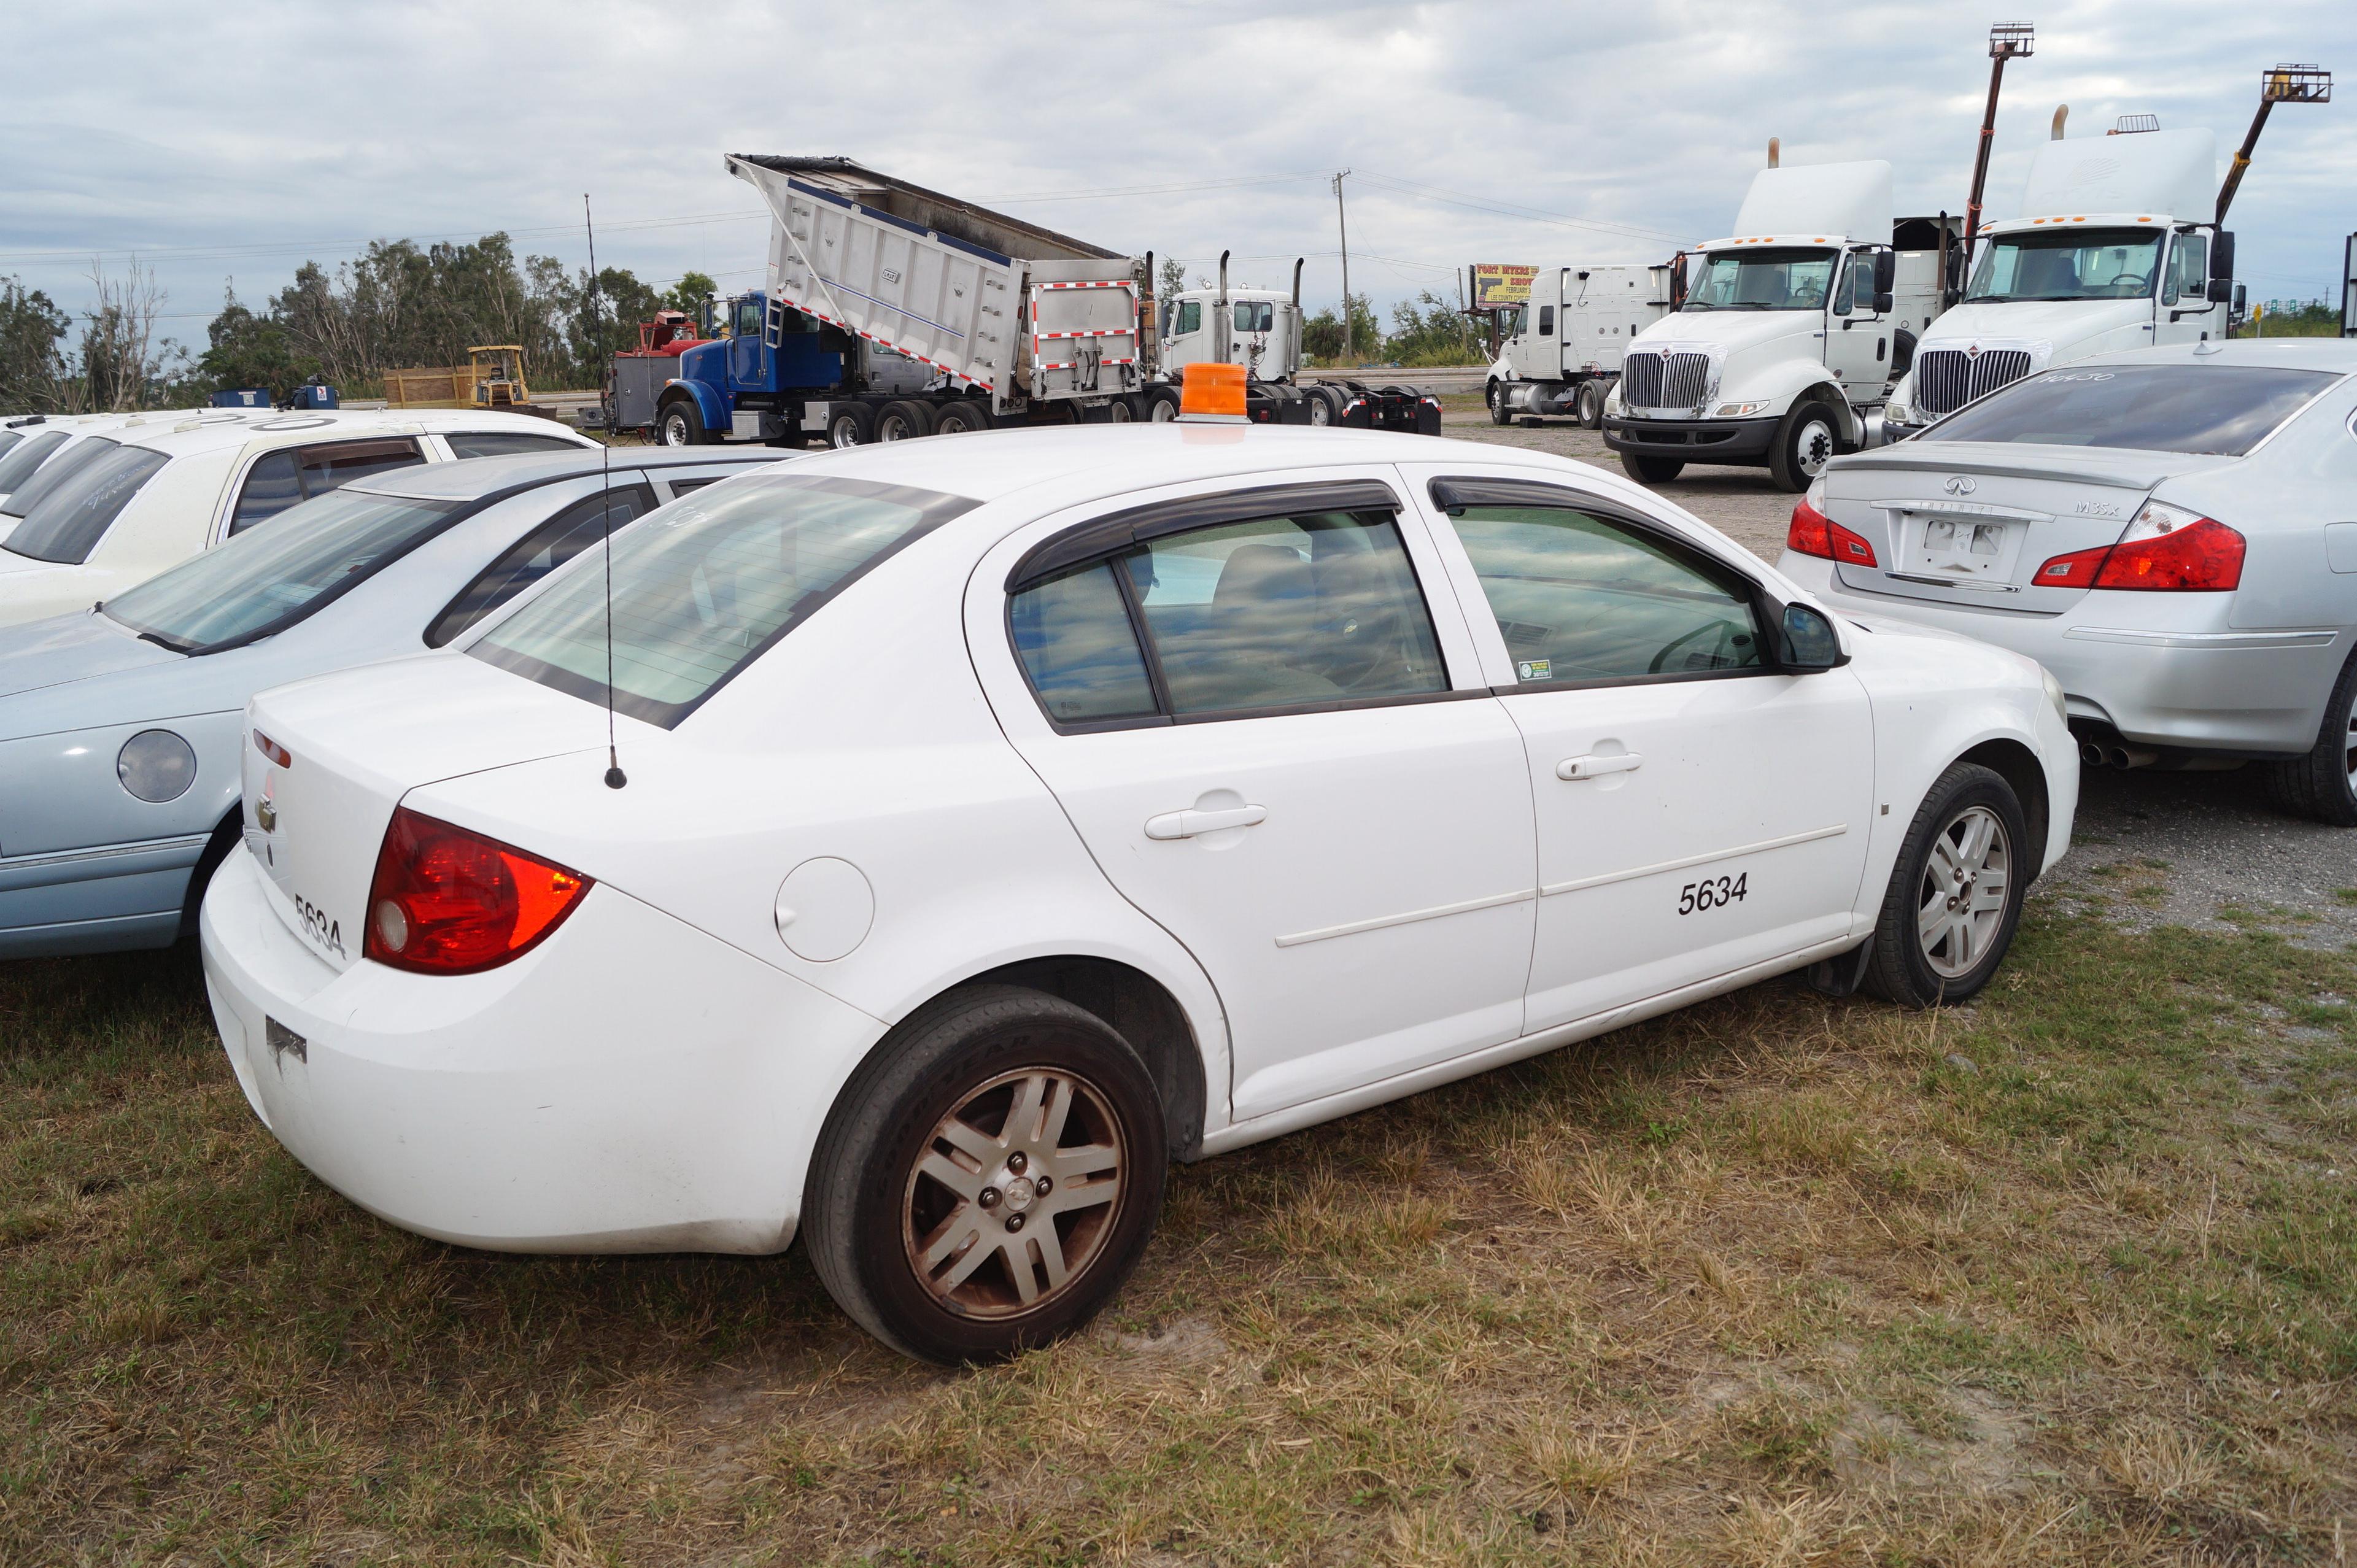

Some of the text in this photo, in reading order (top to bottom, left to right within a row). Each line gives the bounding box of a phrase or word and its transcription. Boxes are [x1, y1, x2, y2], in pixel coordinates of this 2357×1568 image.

[1477, 265, 1498, 274] FORT
[1502, 266, 1529, 275] MYERS
[1920, 501, 1994, 515] INFINITI
[1678, 871, 1747, 916] 5634
[295, 893, 347, 961] 5634
